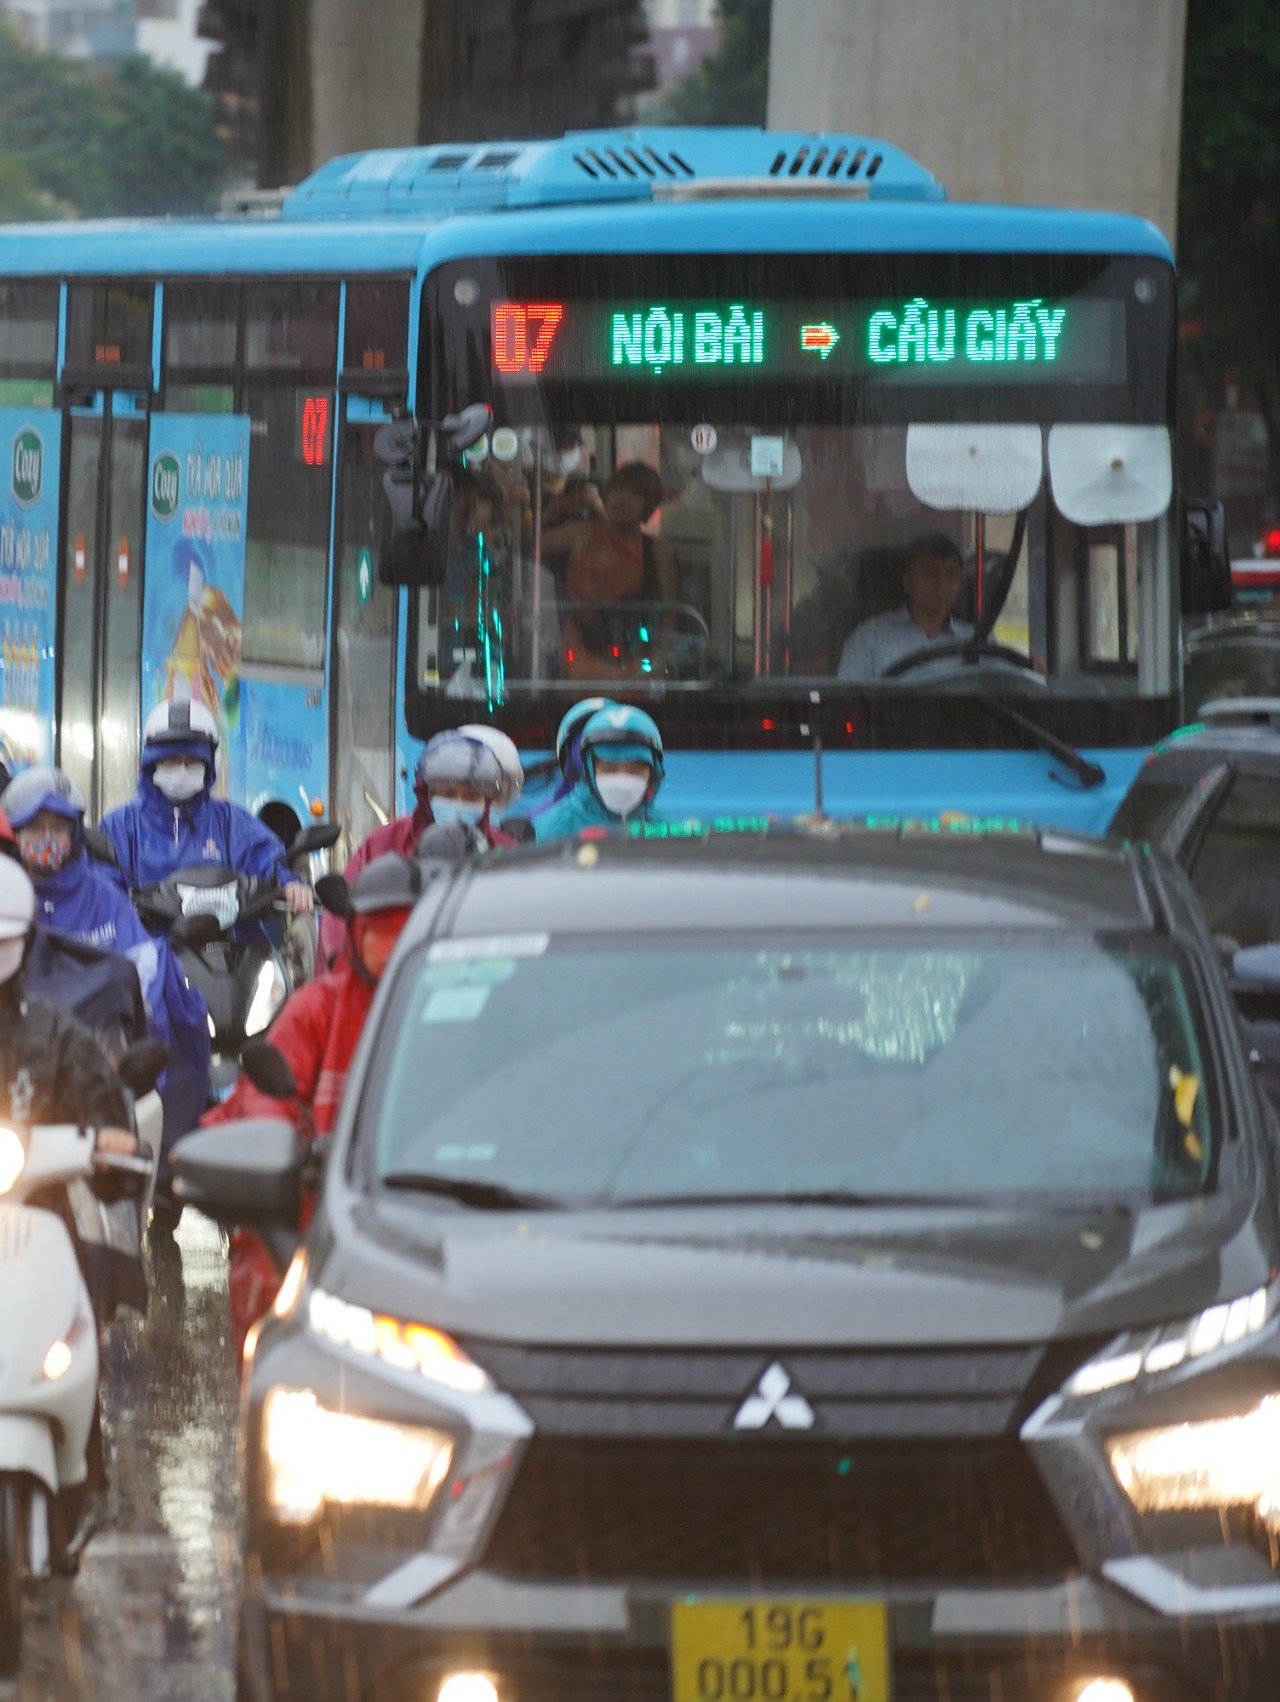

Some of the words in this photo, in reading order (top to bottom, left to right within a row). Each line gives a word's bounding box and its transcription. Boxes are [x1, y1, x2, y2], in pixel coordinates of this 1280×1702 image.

[494, 304, 563, 373] 07
[612, 306, 684, 375] NỘI
[965, 298, 1066, 361] GIẤY
[302, 397, 328, 467] 07
[14, 439, 41, 495] Cozy
[154, 461, 179, 511] Cozy
[738, 1606, 825, 1651] 19G
